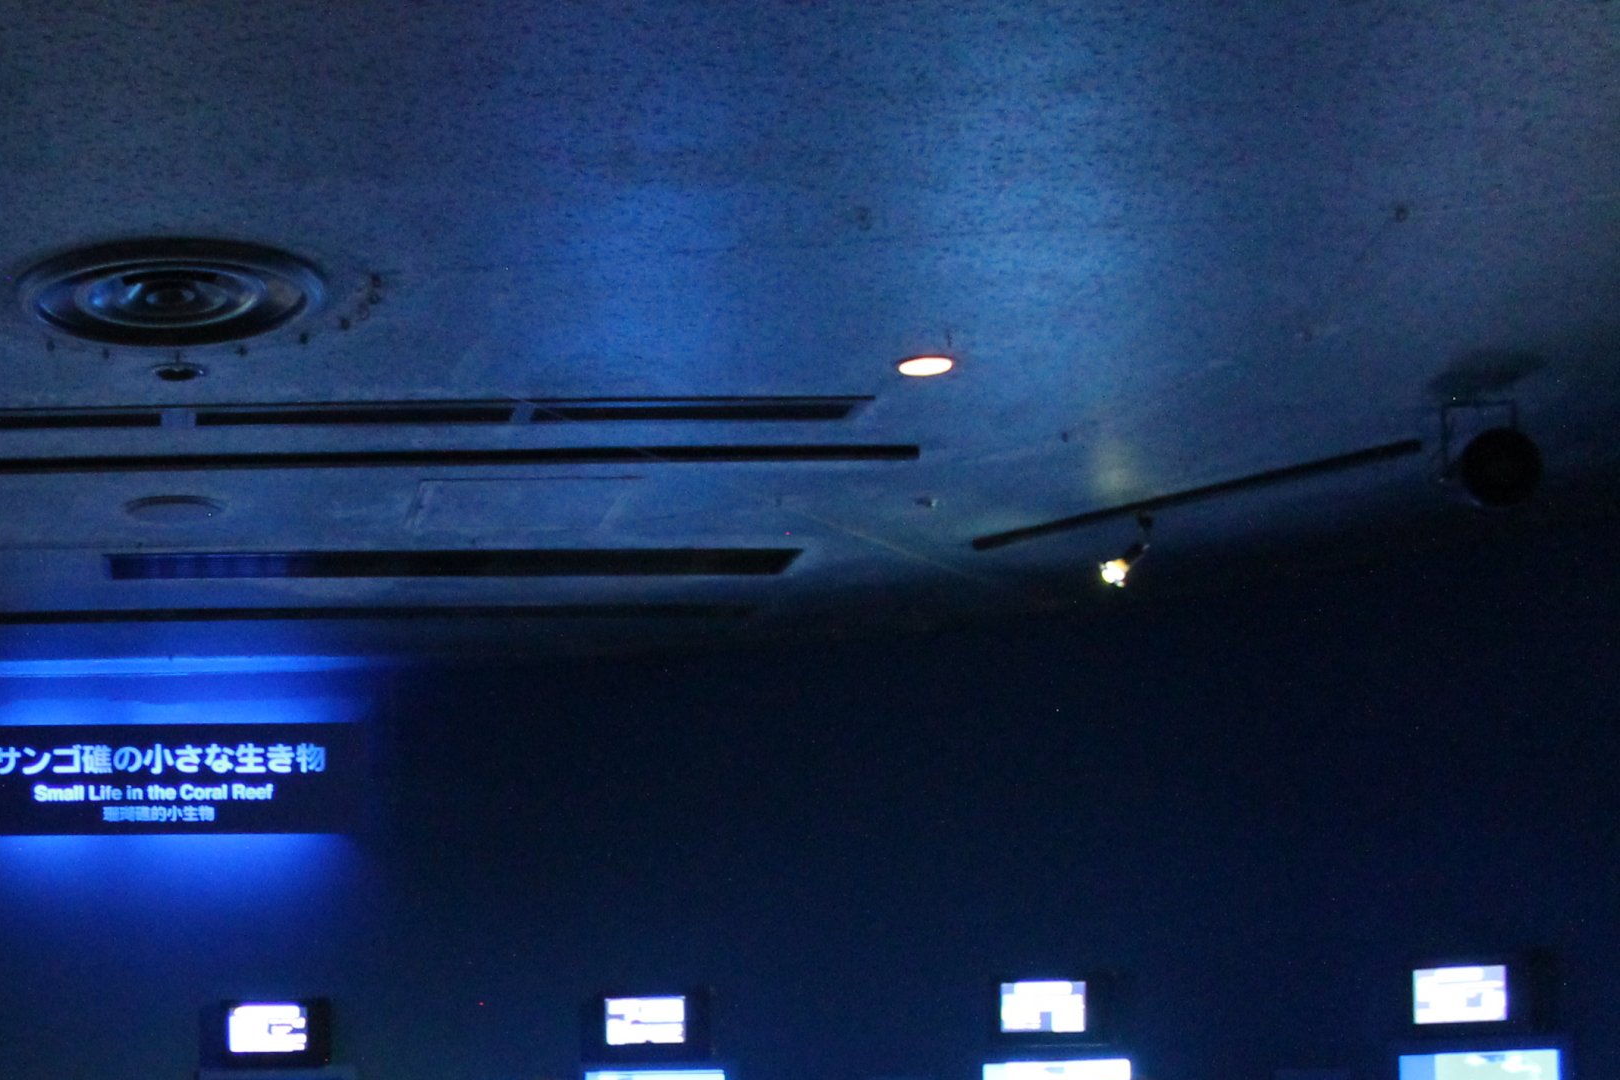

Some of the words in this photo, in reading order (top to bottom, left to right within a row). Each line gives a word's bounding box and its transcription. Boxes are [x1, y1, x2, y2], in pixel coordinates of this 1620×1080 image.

[33, 784, 85, 802] Small
[88, 785, 122, 801] Life
[126, 784, 144, 801] in
[146, 784, 177, 801] the
[179, 784, 228, 801] Coral
[230, 783, 274, 801] Reef
